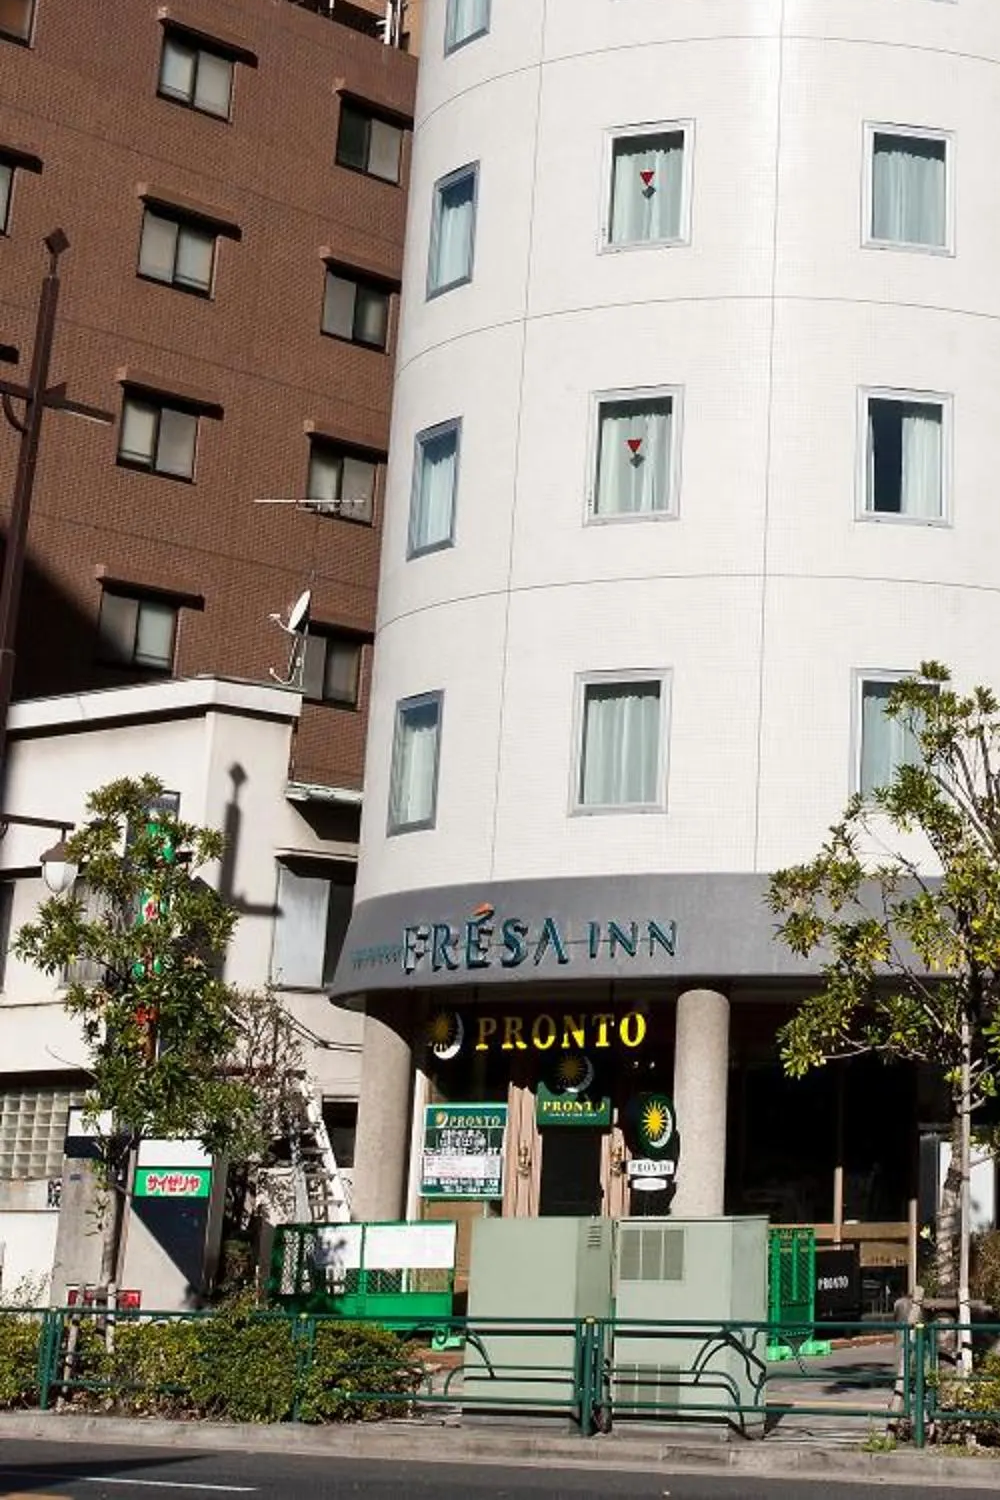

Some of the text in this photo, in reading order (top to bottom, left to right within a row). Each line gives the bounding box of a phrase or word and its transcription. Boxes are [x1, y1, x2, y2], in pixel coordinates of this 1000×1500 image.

[586, 910, 678, 960] INN
[475, 1011, 648, 1052] PRONTO
[448, 1115, 501, 1127] PRONTO
[147, 1173, 200, 1193] サイゼリヤ
